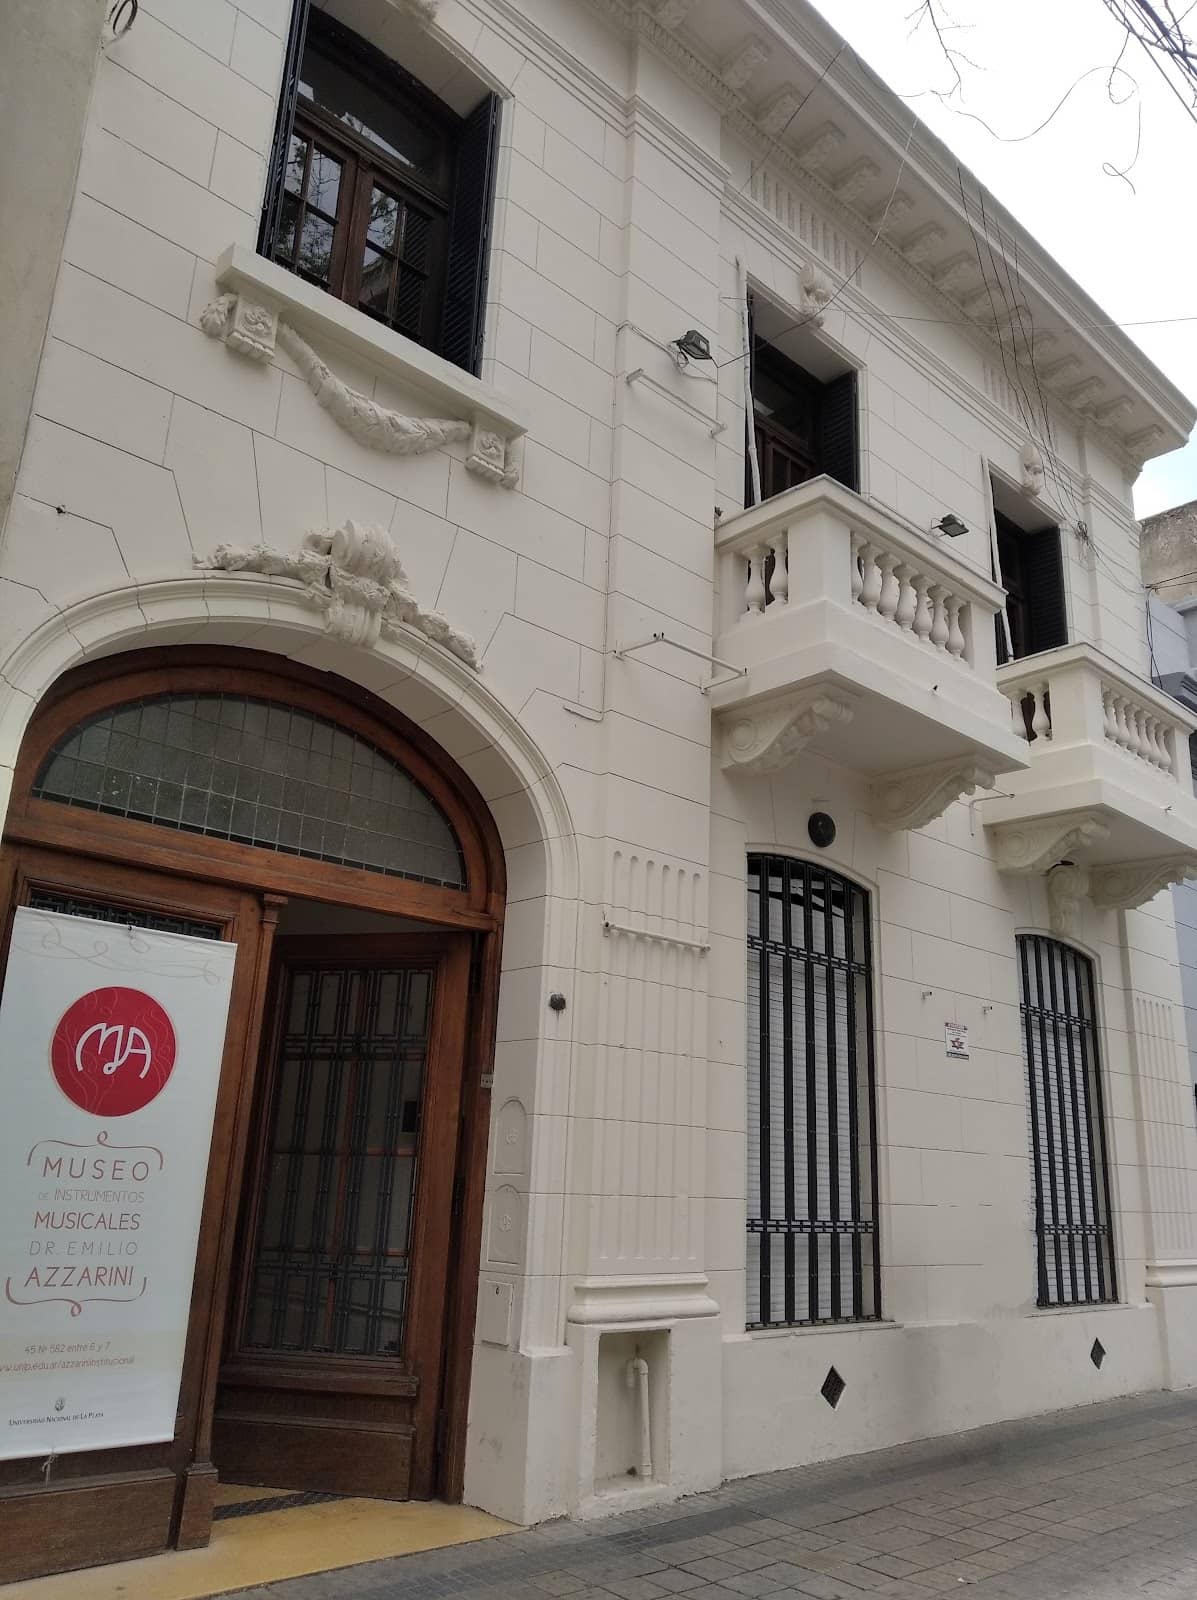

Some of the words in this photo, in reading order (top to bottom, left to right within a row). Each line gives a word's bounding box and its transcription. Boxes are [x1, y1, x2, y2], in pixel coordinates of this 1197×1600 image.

[42, 1156, 149, 1182] MUSEO
[54, 1188, 145, 1204] INSTRUMENTOS
[34, 1211, 141, 1231] MUSICALES
[67, 1241, 138, 1257] EMILIO
[24, 1266, 134, 1288] AZZARINI
[67, 1342, 88, 1353] entre
